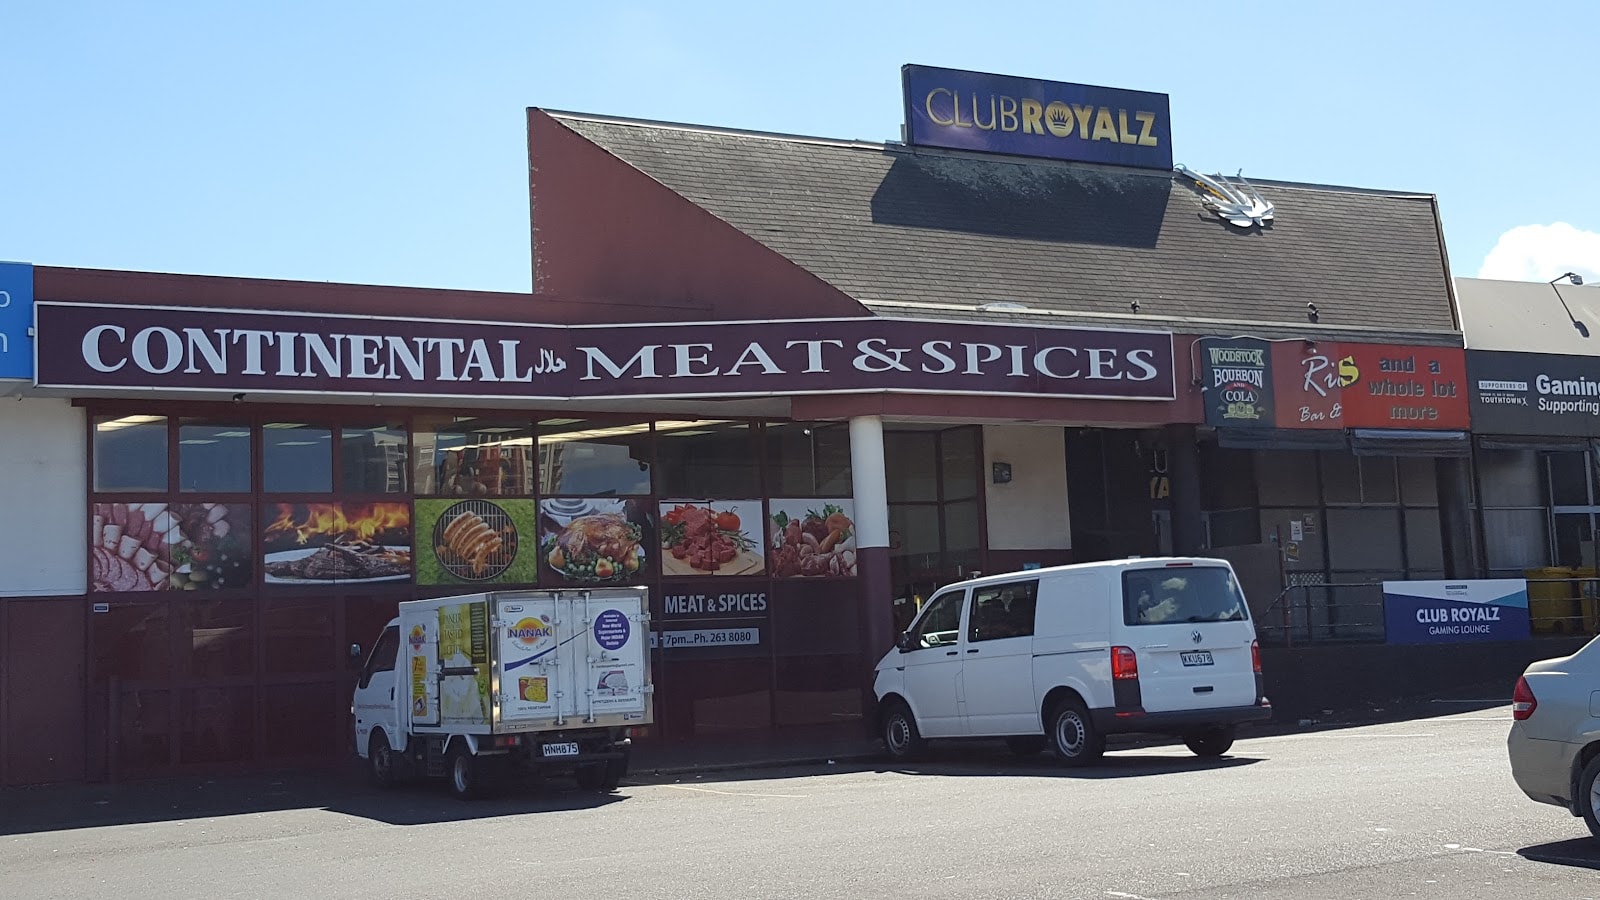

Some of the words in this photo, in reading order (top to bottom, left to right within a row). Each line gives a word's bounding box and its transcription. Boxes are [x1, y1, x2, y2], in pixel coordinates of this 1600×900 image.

[82, 324, 533, 383] CONTINENTAL
[576, 339, 844, 381] MEAT
[921, 340, 1158, 381] SPICES
[1208, 347, 1265, 367] WOODSTOCK
[1380, 356, 1416, 374] and
[1428, 360, 1441, 375] a
[1213, 369, 1264, 389] BOURBON
[1369, 378, 1425, 397] whole
[1432, 380, 1457, 398] lot
[1225, 391, 1255, 402] COLA
[1298, 406, 1326, 422] Bar
[1329, 402, 1342, 419] &
[1390, 404, 1439, 420] more
[1538, 397, 1600, 416] Supporting
[664, 595, 706, 614] MEAT
[707, 598, 716, 612] &
[718, 593, 767, 612] SPICES
[1416, 608, 1448, 623] CLUB
[1451, 607, 1500, 622] ROYALZ
[509, 627, 552, 638] NANAK
[710, 632, 727, 643] 263
[728, 631, 751, 642] 8080
[1429, 626, 1460, 635] GAMING
[1461, 624, 1490, 634] LOUNGE
[544, 744, 578, 755] HNH875
